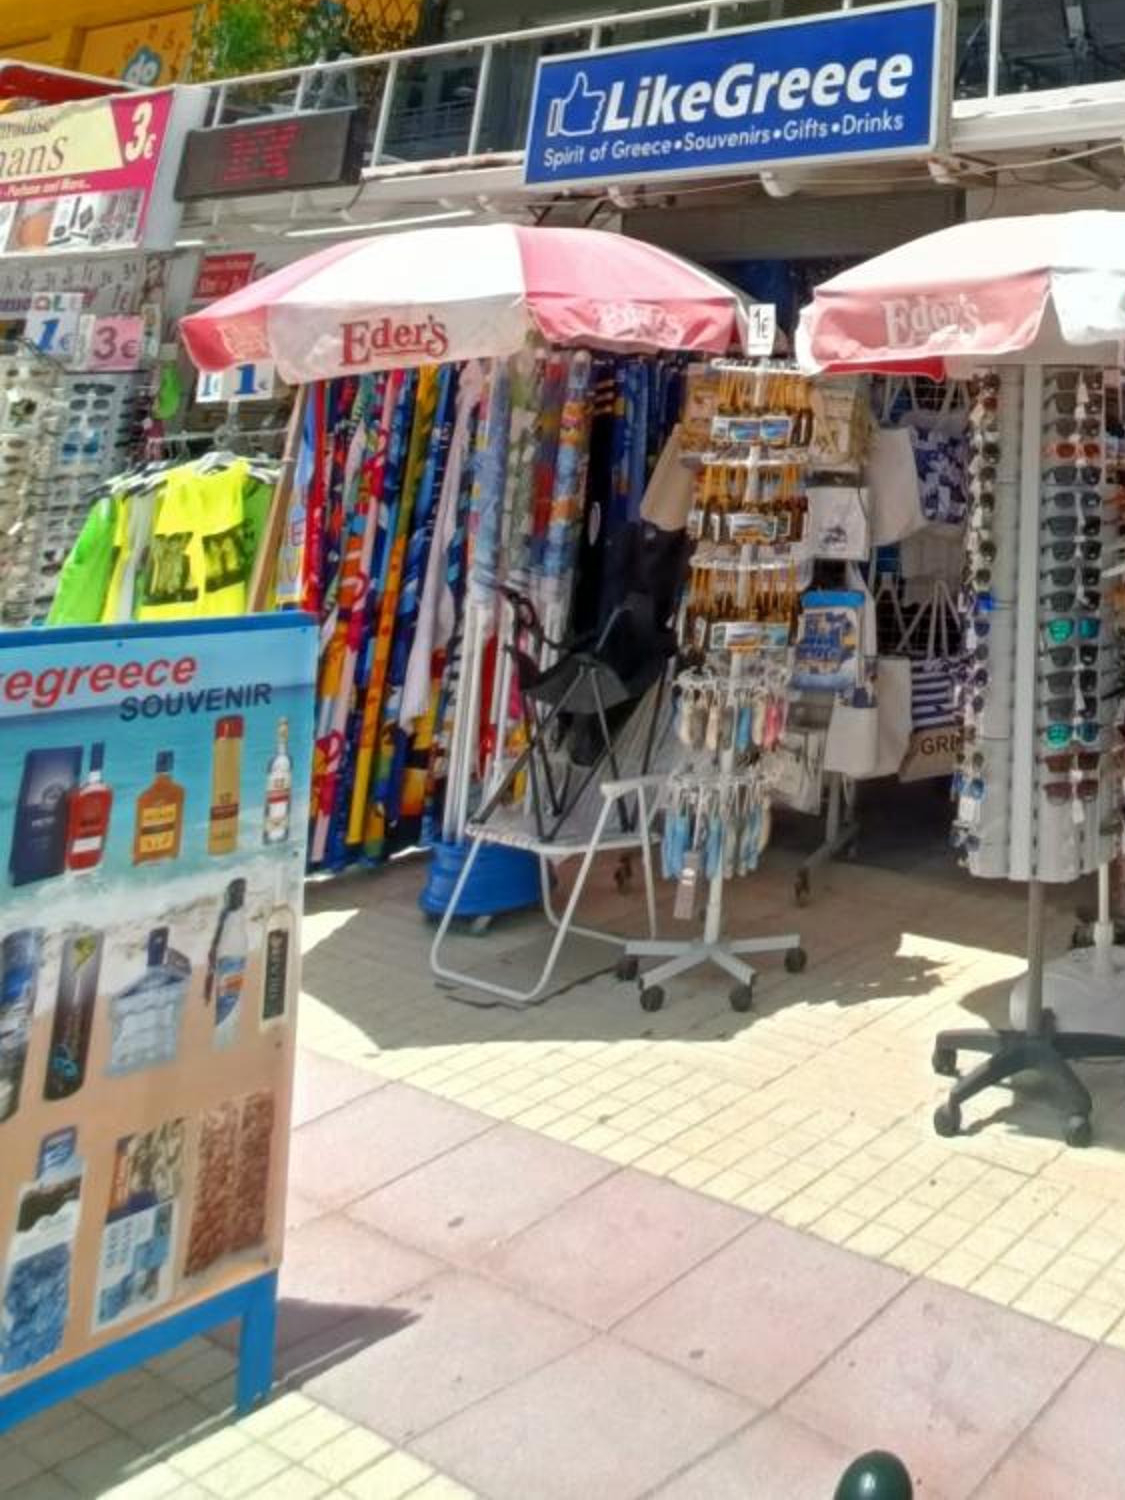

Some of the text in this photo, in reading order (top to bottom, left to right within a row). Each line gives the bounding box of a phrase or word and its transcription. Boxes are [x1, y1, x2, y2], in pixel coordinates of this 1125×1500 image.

[602, 54, 913, 132] LikeGreece
[543, 108, 905, 171] Spirit of Greece Souvenirs Gifts Drinks
[94, 326, 138, 360] 3€
[339, 314, 449, 366] Eder's
[0, 656, 197, 708] egreece
[119, 683, 272, 721] SOUVENIR
